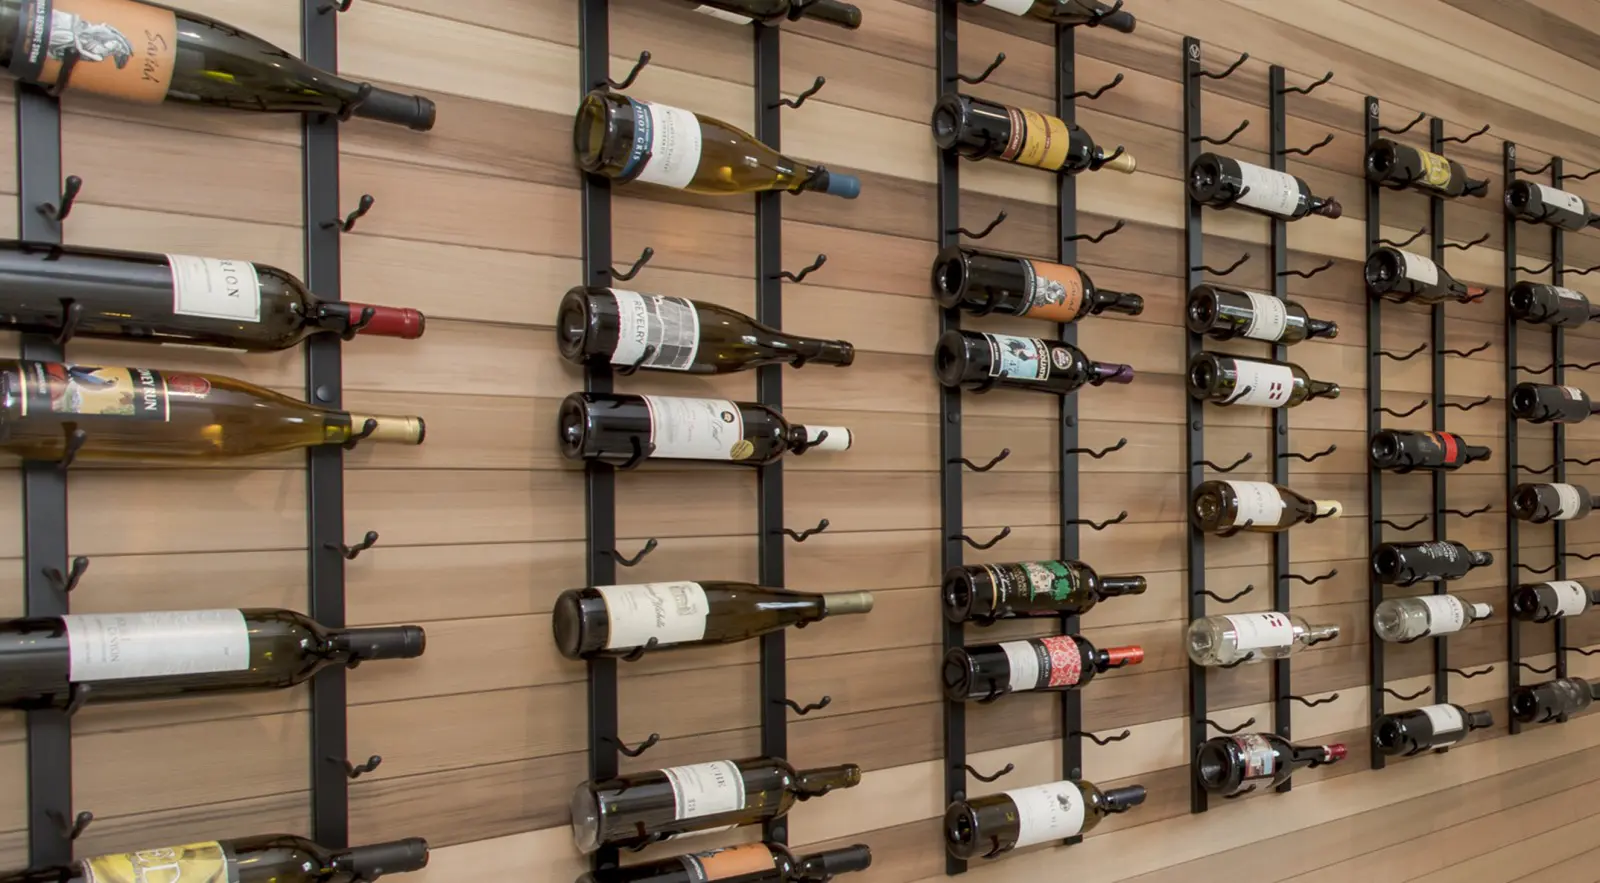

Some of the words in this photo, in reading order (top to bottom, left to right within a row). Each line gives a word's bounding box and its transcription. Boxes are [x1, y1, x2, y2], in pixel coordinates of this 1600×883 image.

[141, 28, 168, 84] Saviah
[635, 105, 645, 133] PINOT
[632, 136, 645, 161] GRIS
[632, 300, 645, 346] REVELRY
[144, 389, 157, 412] RUN
